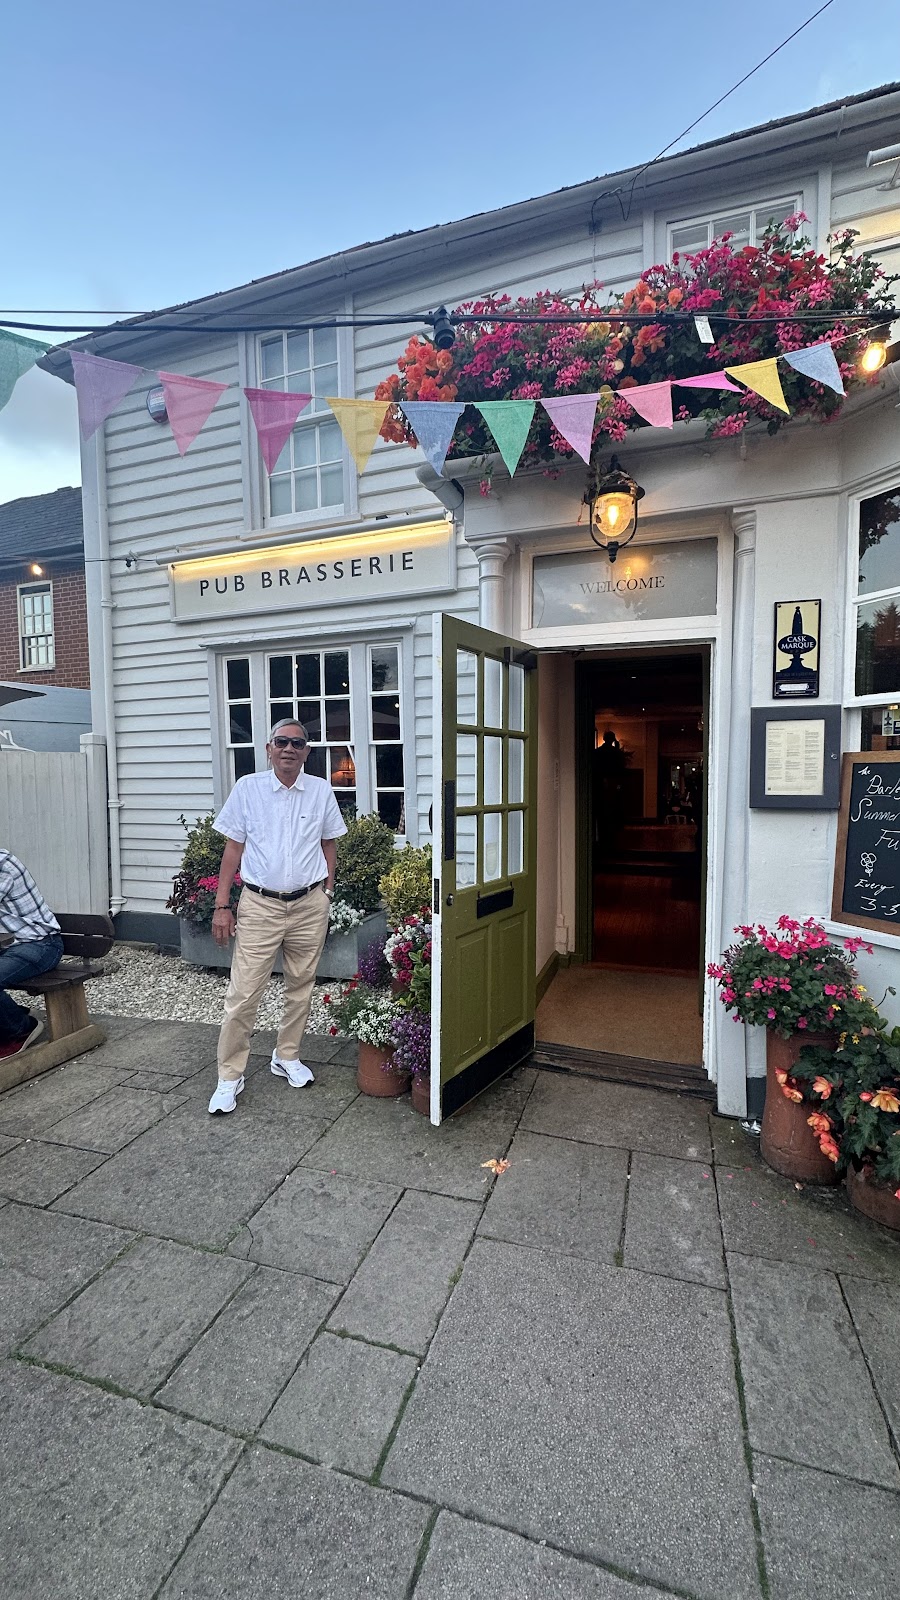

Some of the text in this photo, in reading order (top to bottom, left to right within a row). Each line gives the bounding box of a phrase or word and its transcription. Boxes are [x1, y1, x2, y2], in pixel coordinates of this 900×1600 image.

[200, 552, 414, 596] PUB BRASSERIE
[580, 576, 665, 594] WELCOME
[854, 879, 895, 896] Every
